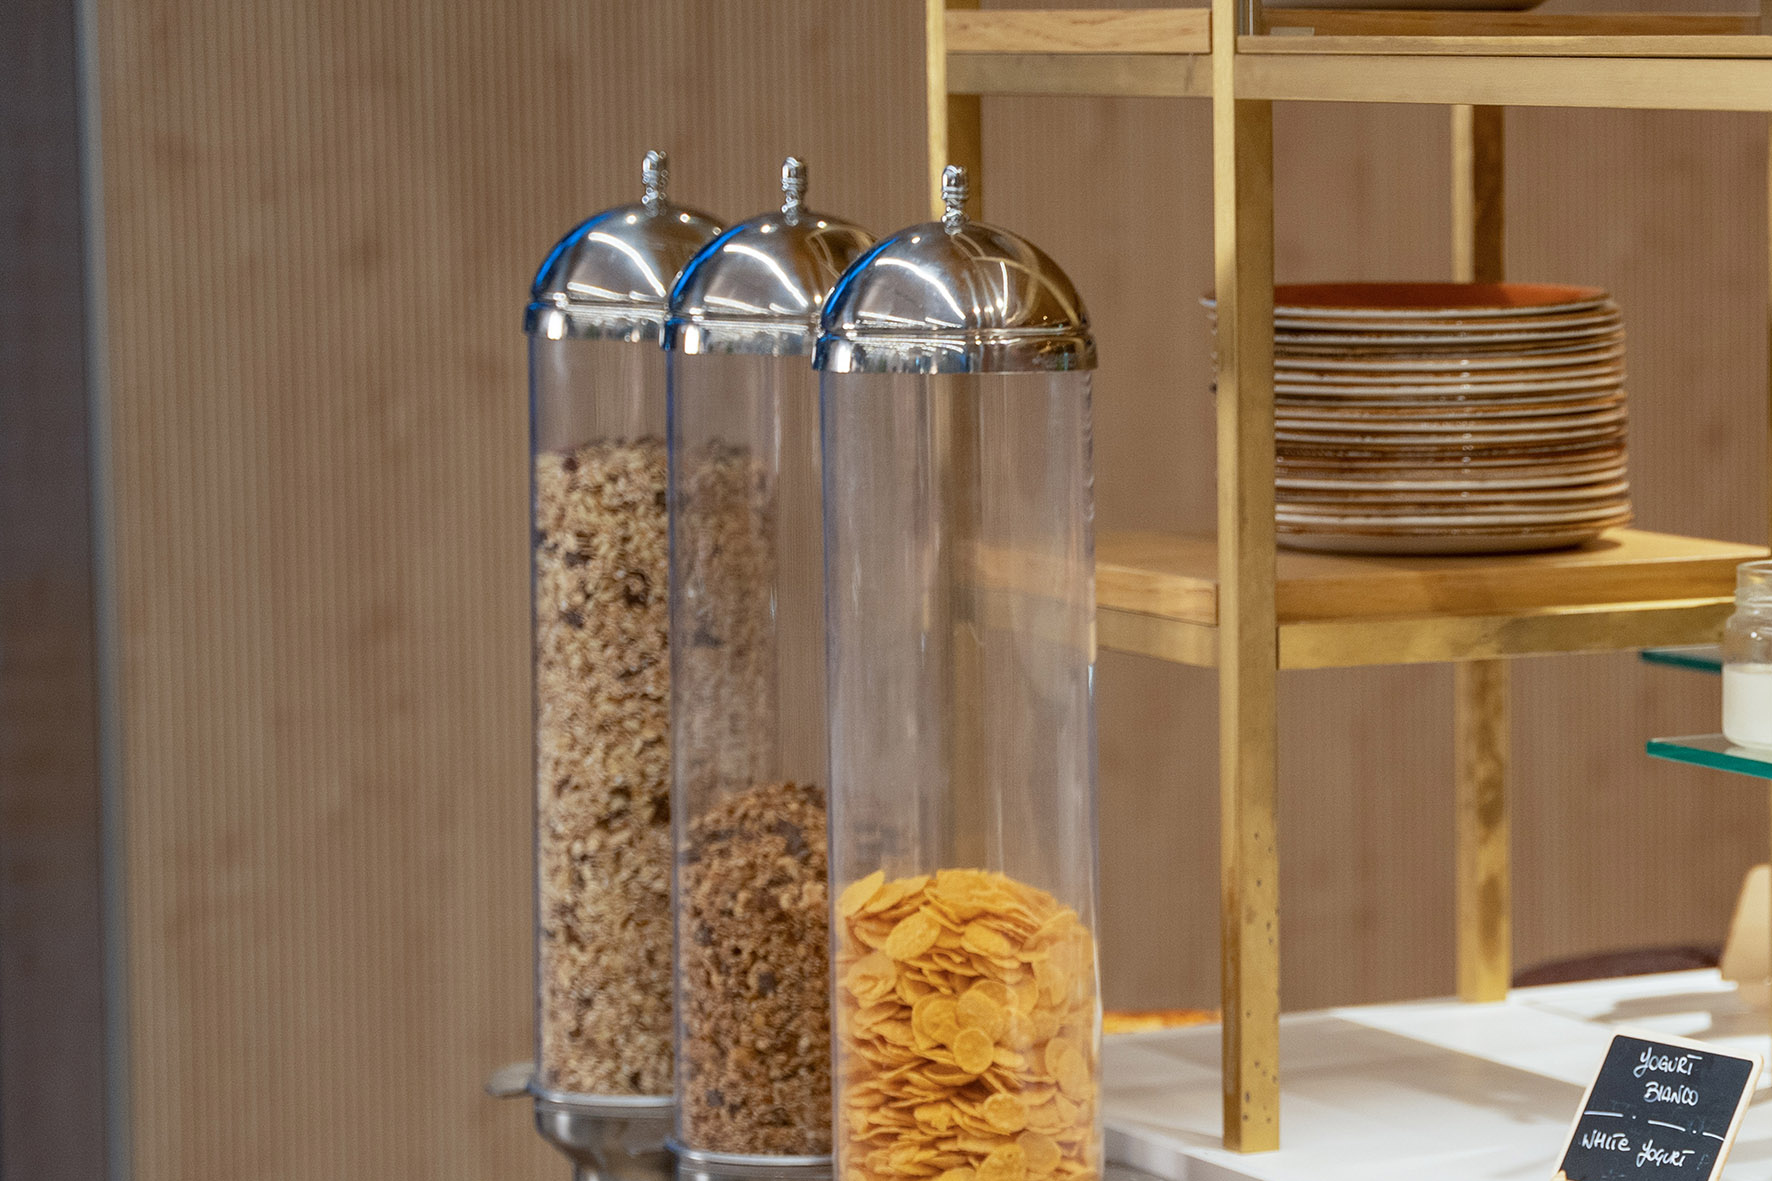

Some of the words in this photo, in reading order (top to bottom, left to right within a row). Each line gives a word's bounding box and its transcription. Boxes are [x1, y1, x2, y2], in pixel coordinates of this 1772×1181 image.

[1633, 1047, 1702, 1078] YOGURT
[1644, 1081, 1698, 1106] BIANCO
[1636, 1139, 1695, 1167] YOGURT
